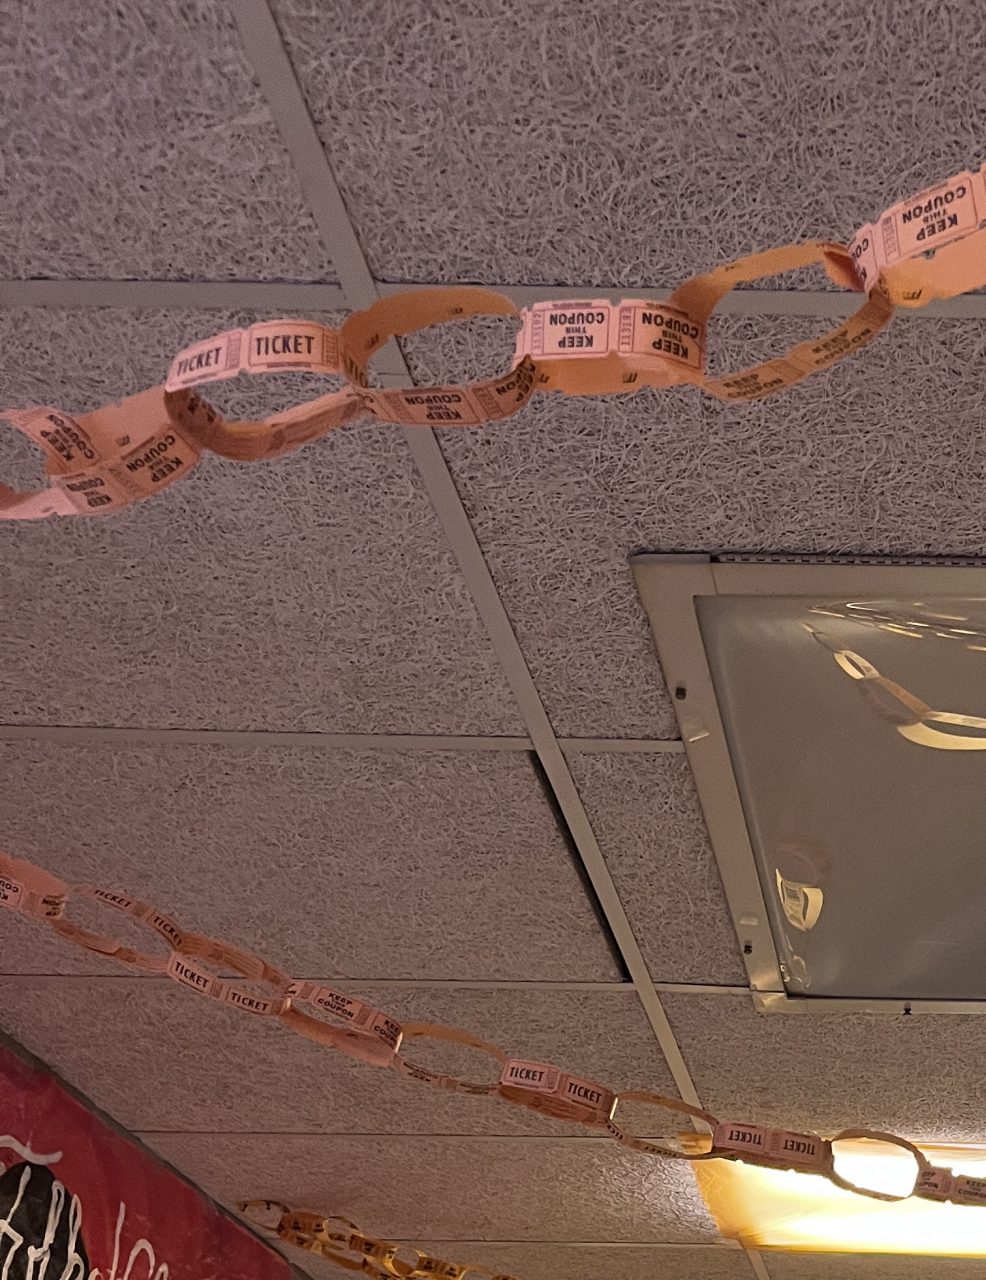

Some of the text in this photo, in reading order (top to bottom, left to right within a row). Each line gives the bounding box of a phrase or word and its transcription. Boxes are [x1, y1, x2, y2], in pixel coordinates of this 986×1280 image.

[902, 185, 967, 225] COUPON
[922, 208, 949, 224] THIS
[916, 213, 959, 241] KEEP
[549, 312, 605, 324] COUPON
[641, 312, 699, 339] COUPON
[565, 326, 587, 335] THIS
[662, 330, 682, 344] THIS
[255, 335, 315, 356] TICKET
[558, 334, 594, 348] KEEP
[652, 338, 689, 360] KEEP
[177, 346, 222, 377] TICKET
[404, 394, 462, 405] COUPON
[426, 410, 462, 420] KEEP
[126, 434, 176, 472] COUPON
[151, 456, 183, 482] KEEP
[94, 888, 132, 908] TICKET
[153, 915, 183, 947] TICKET
[174, 961, 210, 988] TICKET
[230, 991, 269, 1012] TICKET
[317, 997, 354, 1018] COUPON
[328, 992, 353, 1006] KEEP
[384, 1019, 400, 1034] KEE
[509, 1066, 545, 1082] TICKET
[567, 1081, 602, 1104] TICKET
[728, 1129, 762, 1146] TICKET
[783, 1138, 816, 1156] TICKET
[966, 1180, 986, 1188] KEEP
